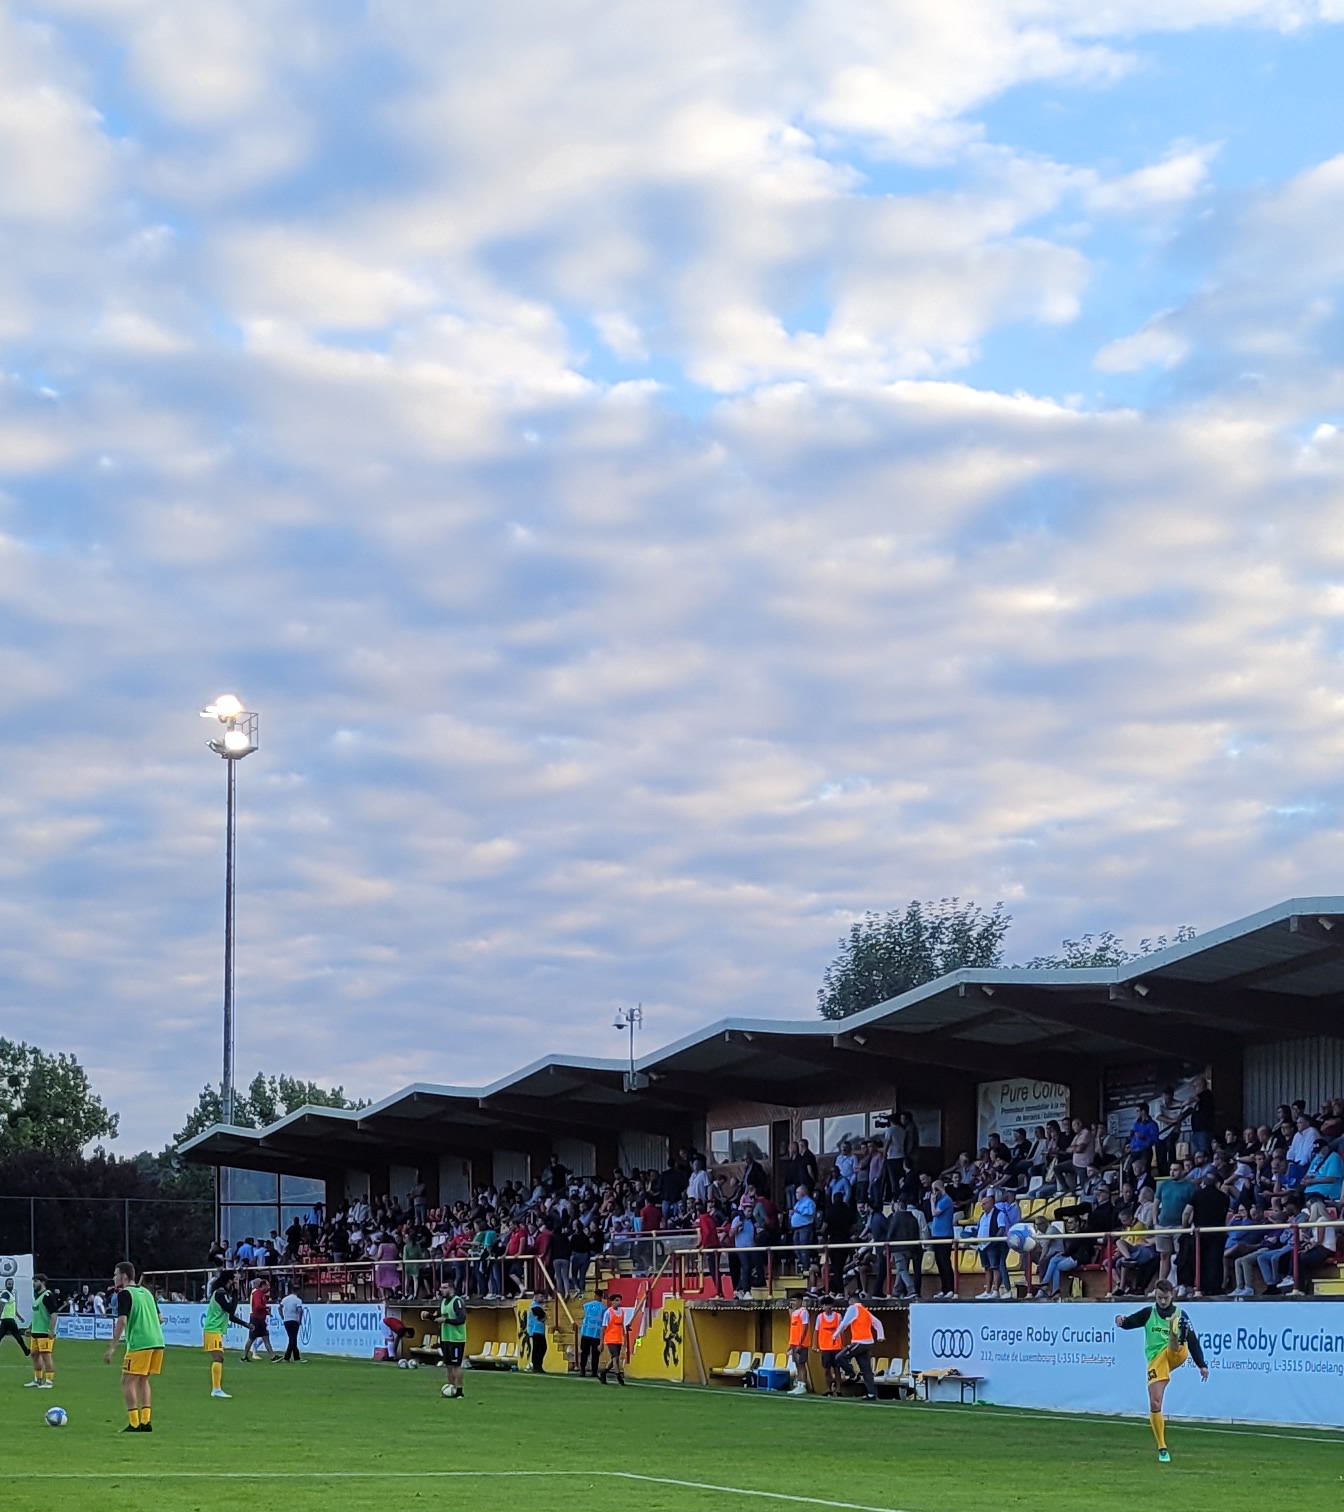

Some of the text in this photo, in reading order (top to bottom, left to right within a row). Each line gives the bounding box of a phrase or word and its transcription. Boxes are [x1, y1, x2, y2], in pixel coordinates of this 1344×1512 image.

[1001, 1084, 1028, 1104] Pure
[981, 1326, 1115, 1346] Garage Roby Cruciani
[1198, 1332, 1232, 1355] rage
[1237, 1327, 1277, 1357] Roby
[994, 1352, 1010, 1362] route
[1011, 1351, 1018, 1361] de
[1057, 1353, 1080, 1364] L-3515
[1211, 1358, 1220, 1369] de
[1222, 1358, 1272, 1373] Luxembourg,
[1274, 1359, 1303, 1372] L-3515
